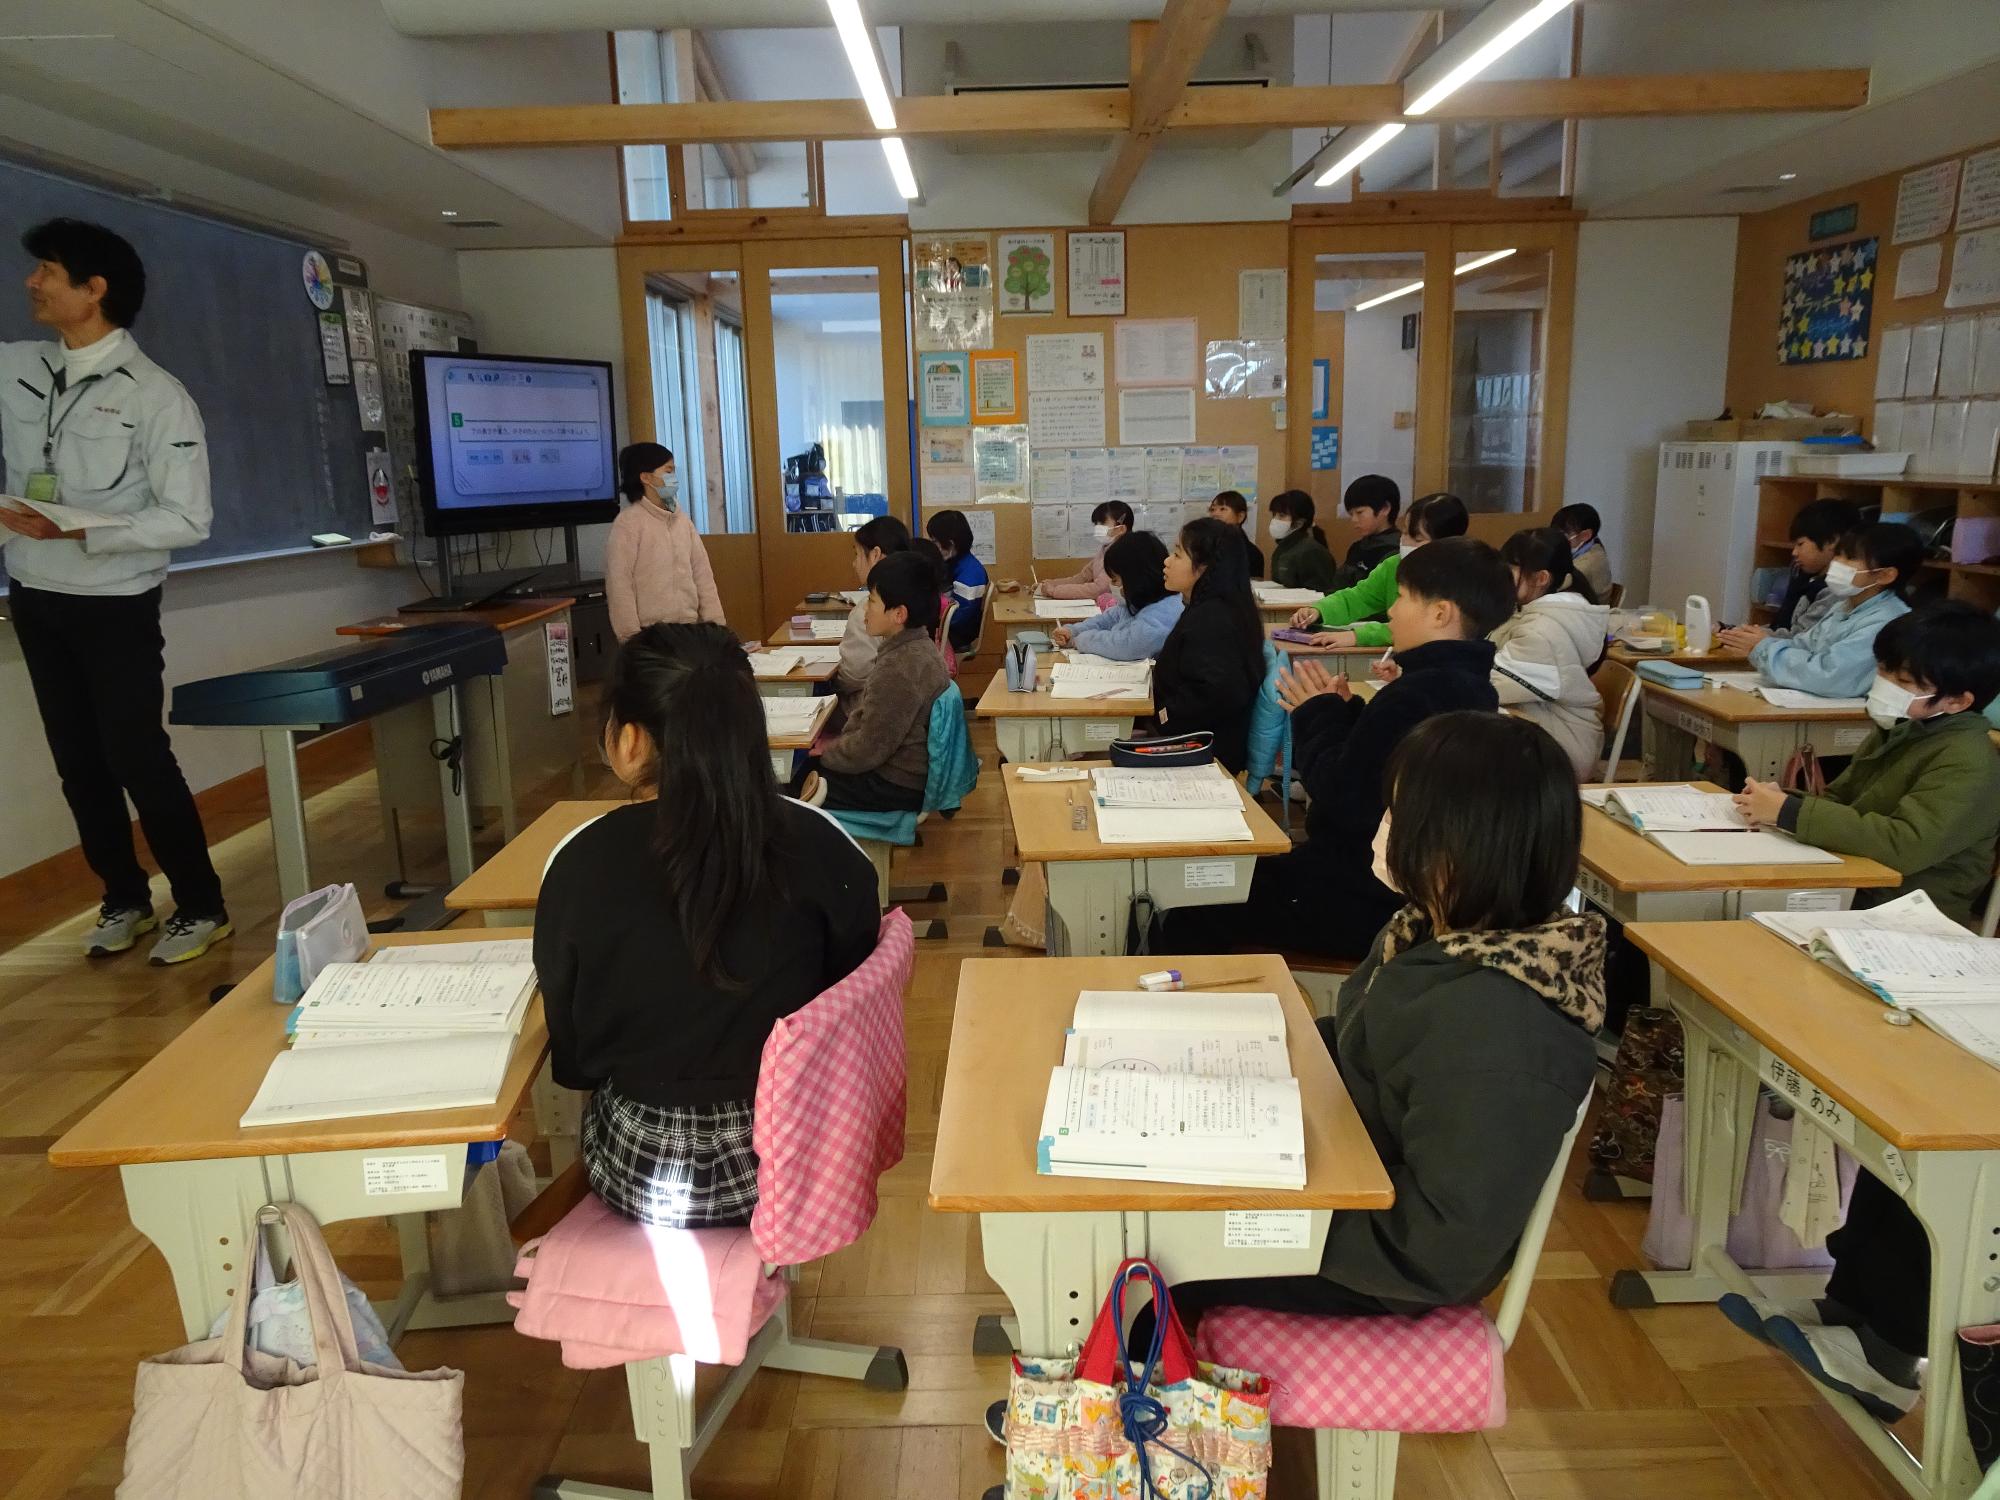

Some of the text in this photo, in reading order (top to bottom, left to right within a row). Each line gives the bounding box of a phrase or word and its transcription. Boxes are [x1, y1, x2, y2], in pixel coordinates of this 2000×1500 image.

[429, 664, 452, 681] YAMAHA
[1771, 1058, 1840, 1124] 伊藤 あみ
